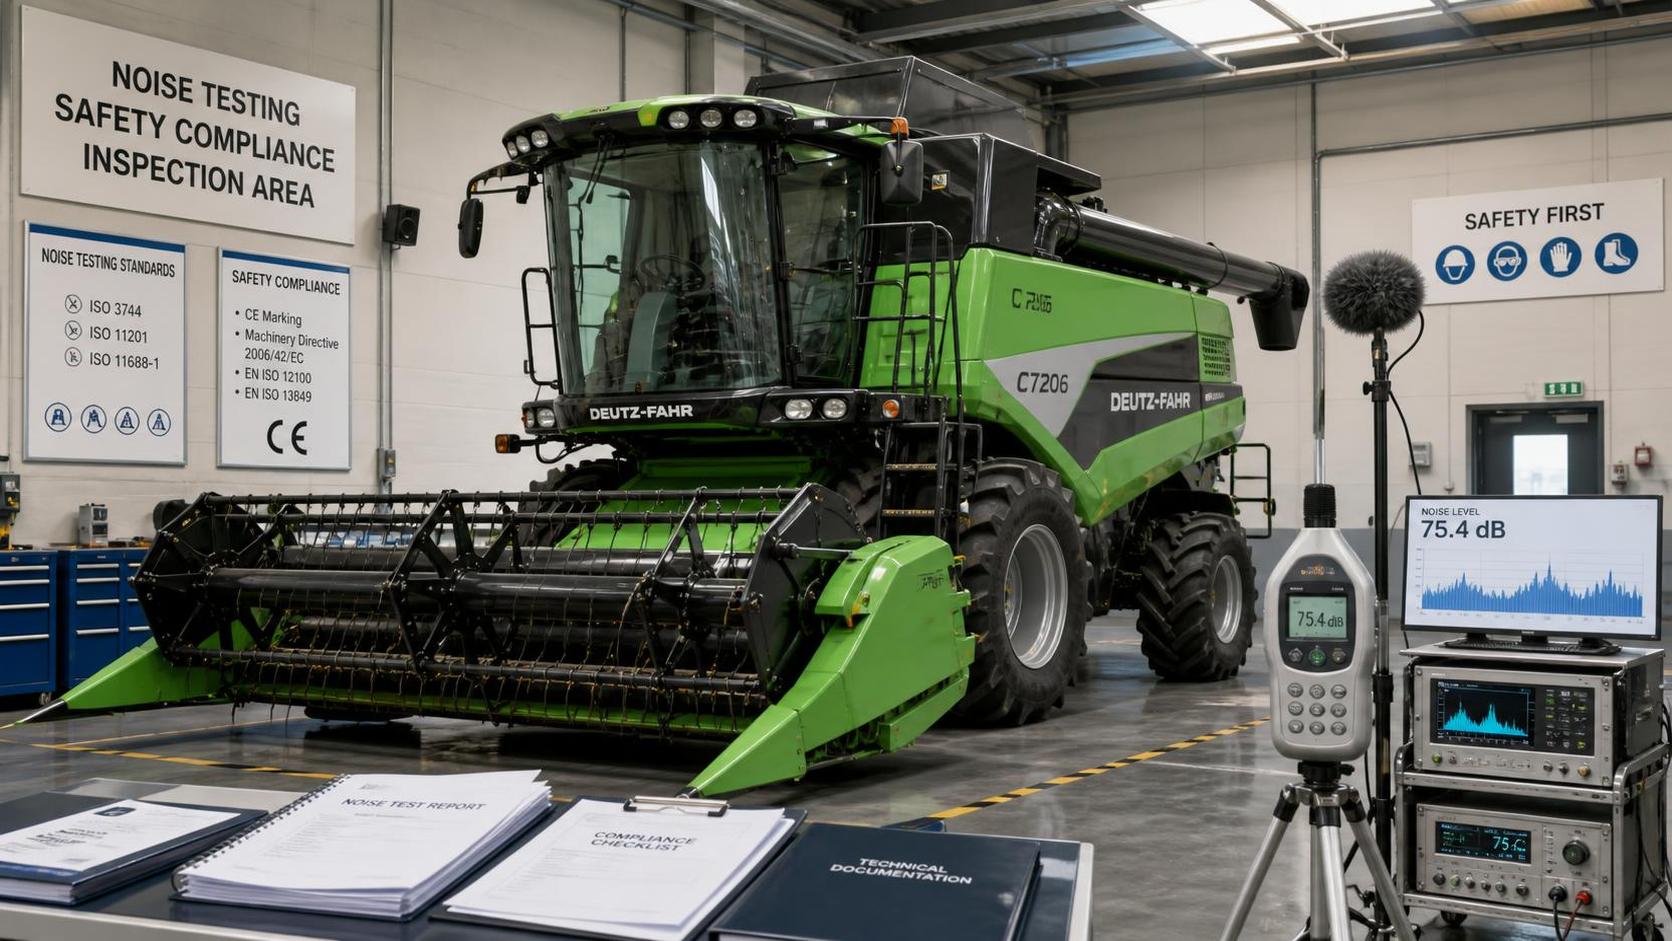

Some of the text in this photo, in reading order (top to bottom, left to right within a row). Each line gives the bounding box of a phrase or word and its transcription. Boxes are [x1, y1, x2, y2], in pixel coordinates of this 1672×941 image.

[112, 60, 301, 126] NOISE TESTING
[54, 93, 335, 173] SAFETY COMPLIANCE
[83, 143, 315, 208] INSPECTION AREA
[1465, 202, 1605, 230] SAFETY FIRST
[41, 247, 175, 278] NOISE TESTING STANDARDS
[232, 270, 341, 296] SAFETY COMPLIANCE
[89, 299, 142, 317] ISO 3744
[245, 308, 302, 328] CE Marking
[89, 326, 148, 343] ISO 11201
[245, 329, 339, 350] Machinery Directive
[89, 352, 159, 370] ISO 11688-1
[245, 347, 304, 364] 2006/42/EC
[245, 367, 312, 384] EN ISO 12100
[1017, 372, 1069, 393] C7206
[245, 387, 312, 403] EN ISO 13849
[1110, 391, 1191, 412] DEUTZ-FAHR
[589, 404, 694, 420] DEUTZ-FAHR
[266, 419, 307, 456] CE
[1421, 507, 1480, 517] NOISE LEVEL
[1421, 520, 1506, 539] 75.4 dB
[1297, 611, 1326, 628] 75.4
[341, 798, 487, 811] NOISE TEST REPORT
[591, 839, 683, 852] CHECKLIST
[594, 831, 697, 845] COMPLIANCE
[829, 864, 973, 885] DOCUMENTATION
[858, 858, 947, 874] TECHNICAL
